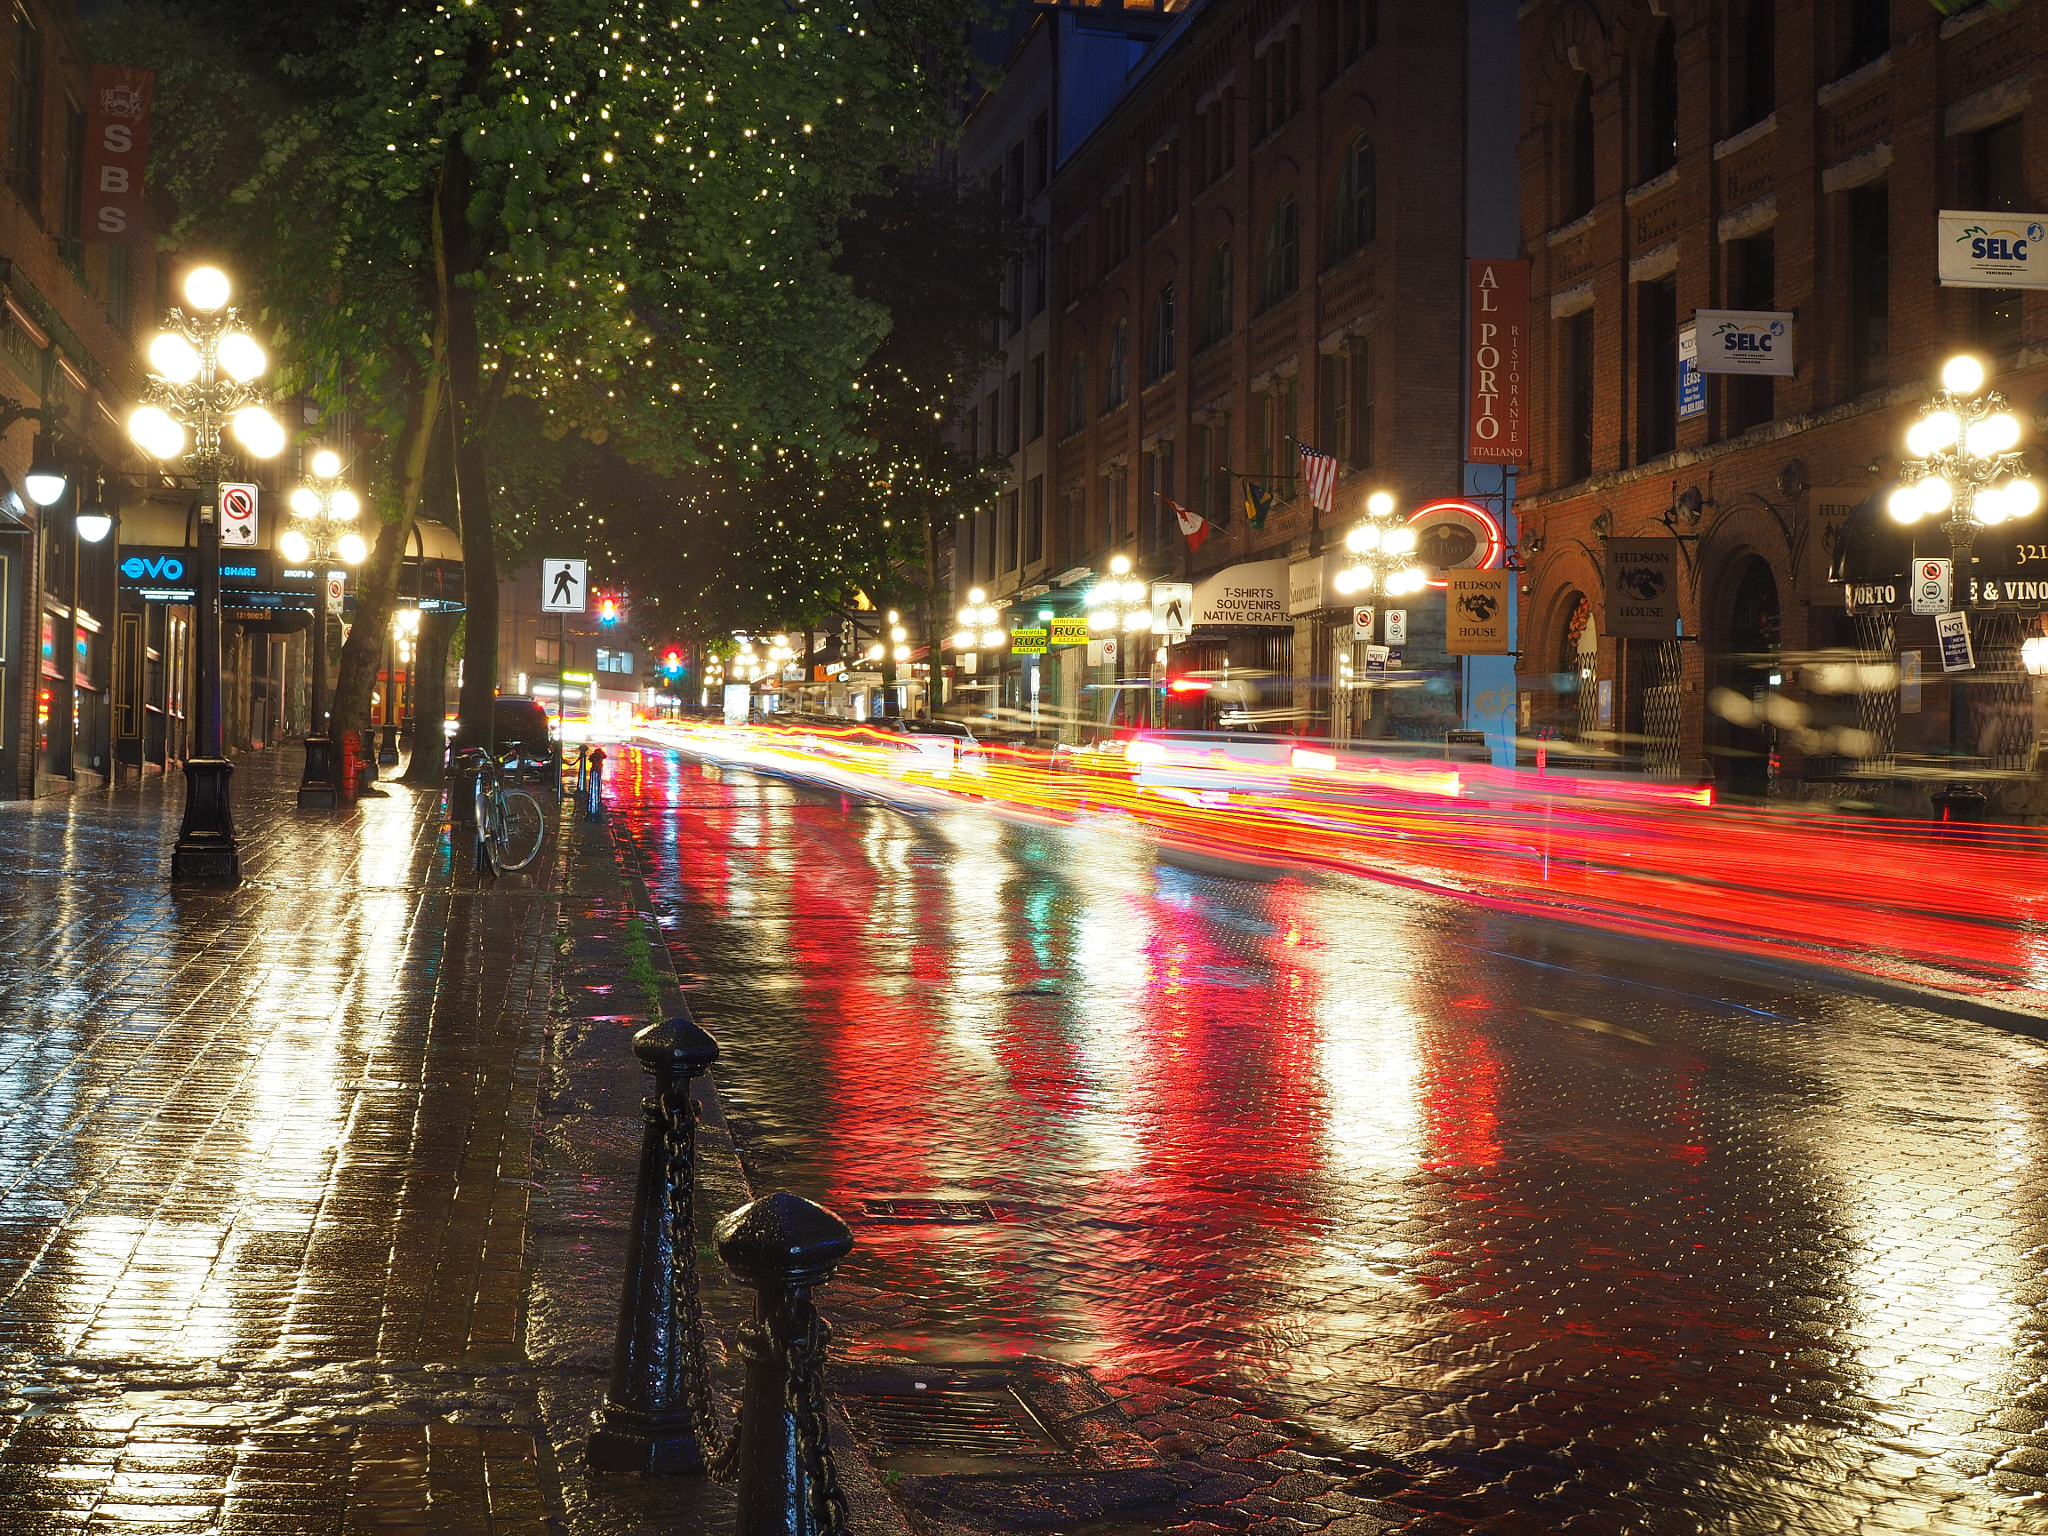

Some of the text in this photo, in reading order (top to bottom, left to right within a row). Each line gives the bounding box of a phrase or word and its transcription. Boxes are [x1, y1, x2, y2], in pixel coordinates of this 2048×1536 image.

[1971, 237, 2027, 261] SELC
[1724, 332, 1772, 352] SELC
[1476, 265, 1500, 440] AL PORTO
[1509, 325, 1520, 441] RISTORANTE
[1683, 372, 1701, 387] LEASE
[1473, 446, 1523, 457] ITALIANO
[1614, 552, 1669, 563] HUDSON
[2016, 544, 2048, 565] 321
[120, 555, 184, 580] evo
[225, 566, 258, 578] SHARE
[1454, 581, 1502, 590] HUDSON
[1983, 581, 1999, 601] &
[2004, 581, 2048, 600] VINO
[1224, 587, 1274, 598] T-SHIRTS
[1216, 599, 1281, 610] SOUVENIRS
[1203, 610, 1293, 622] NATIVE CRAFTS
[1619, 606, 1664, 617] HOUSE
[1053, 626, 1087, 636] RUG
[1459, 628, 1497, 637] HOUSE
[1013, 637, 1045, 646] RUG
